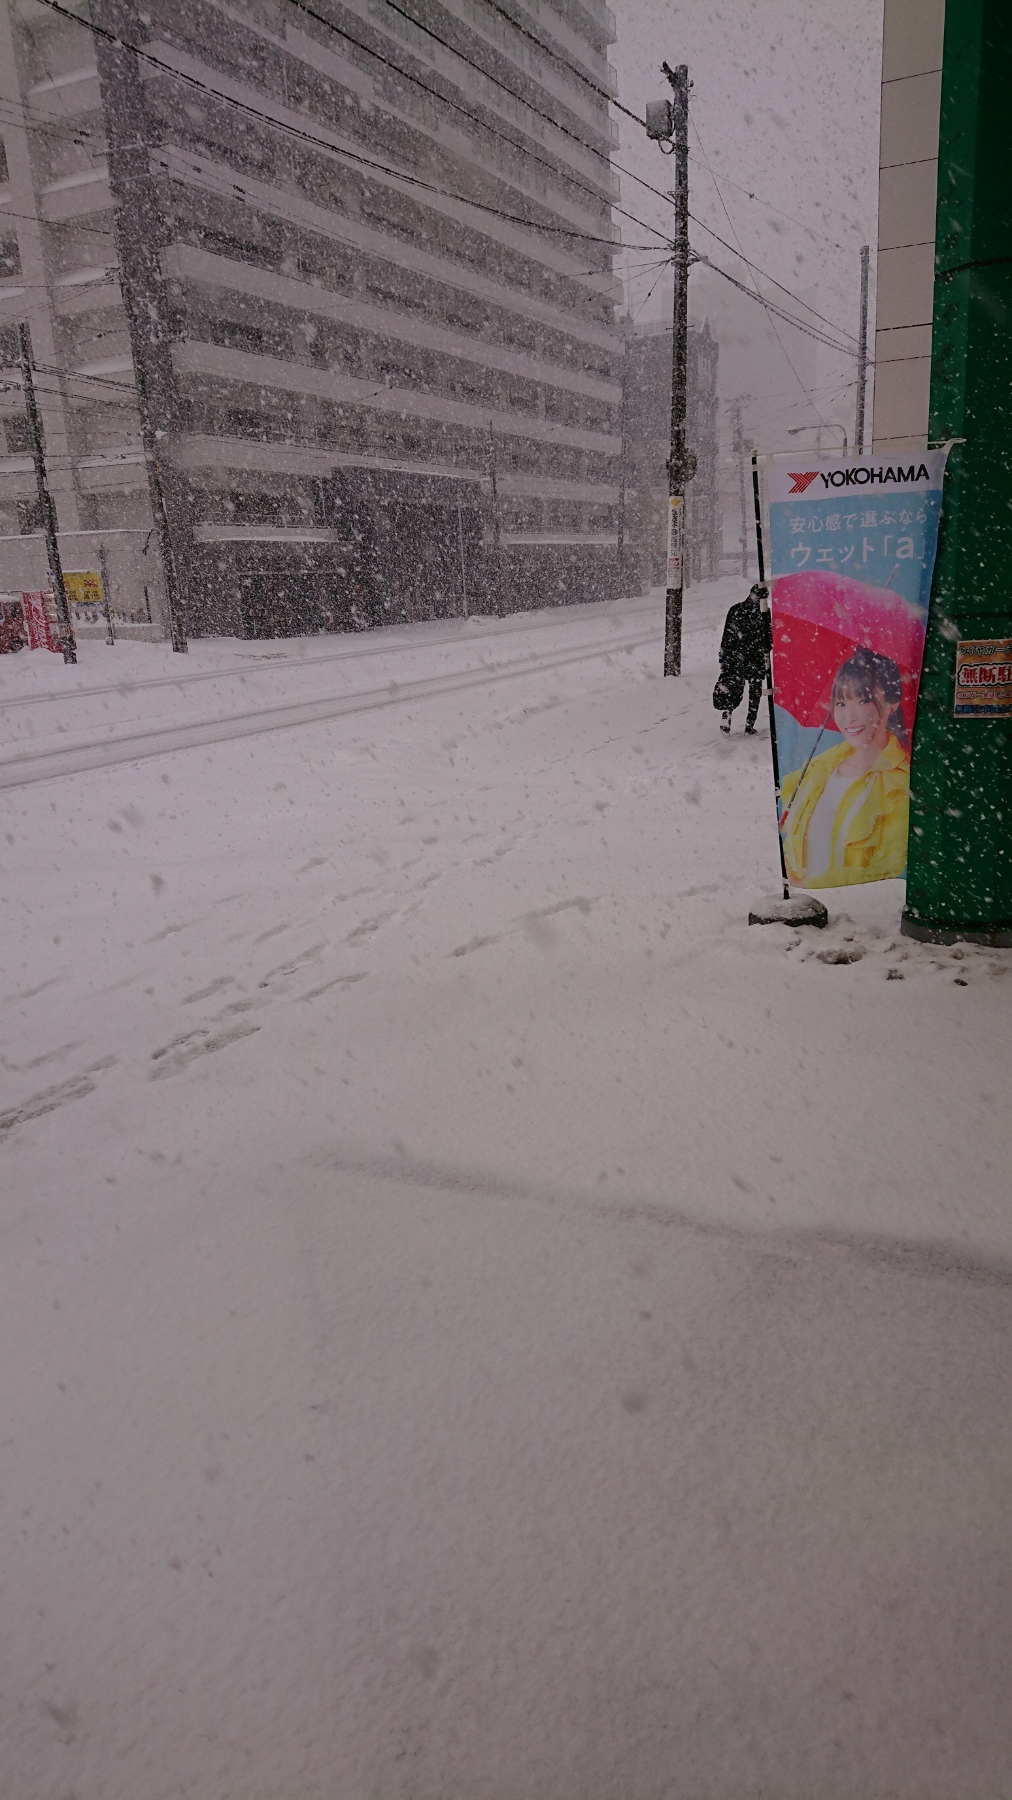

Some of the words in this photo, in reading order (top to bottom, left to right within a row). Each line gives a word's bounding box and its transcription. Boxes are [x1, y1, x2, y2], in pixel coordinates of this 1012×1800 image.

[820, 464, 930, 489] YOKOHAMA
[789, 508, 928, 534] 安心感で選ぶなら
